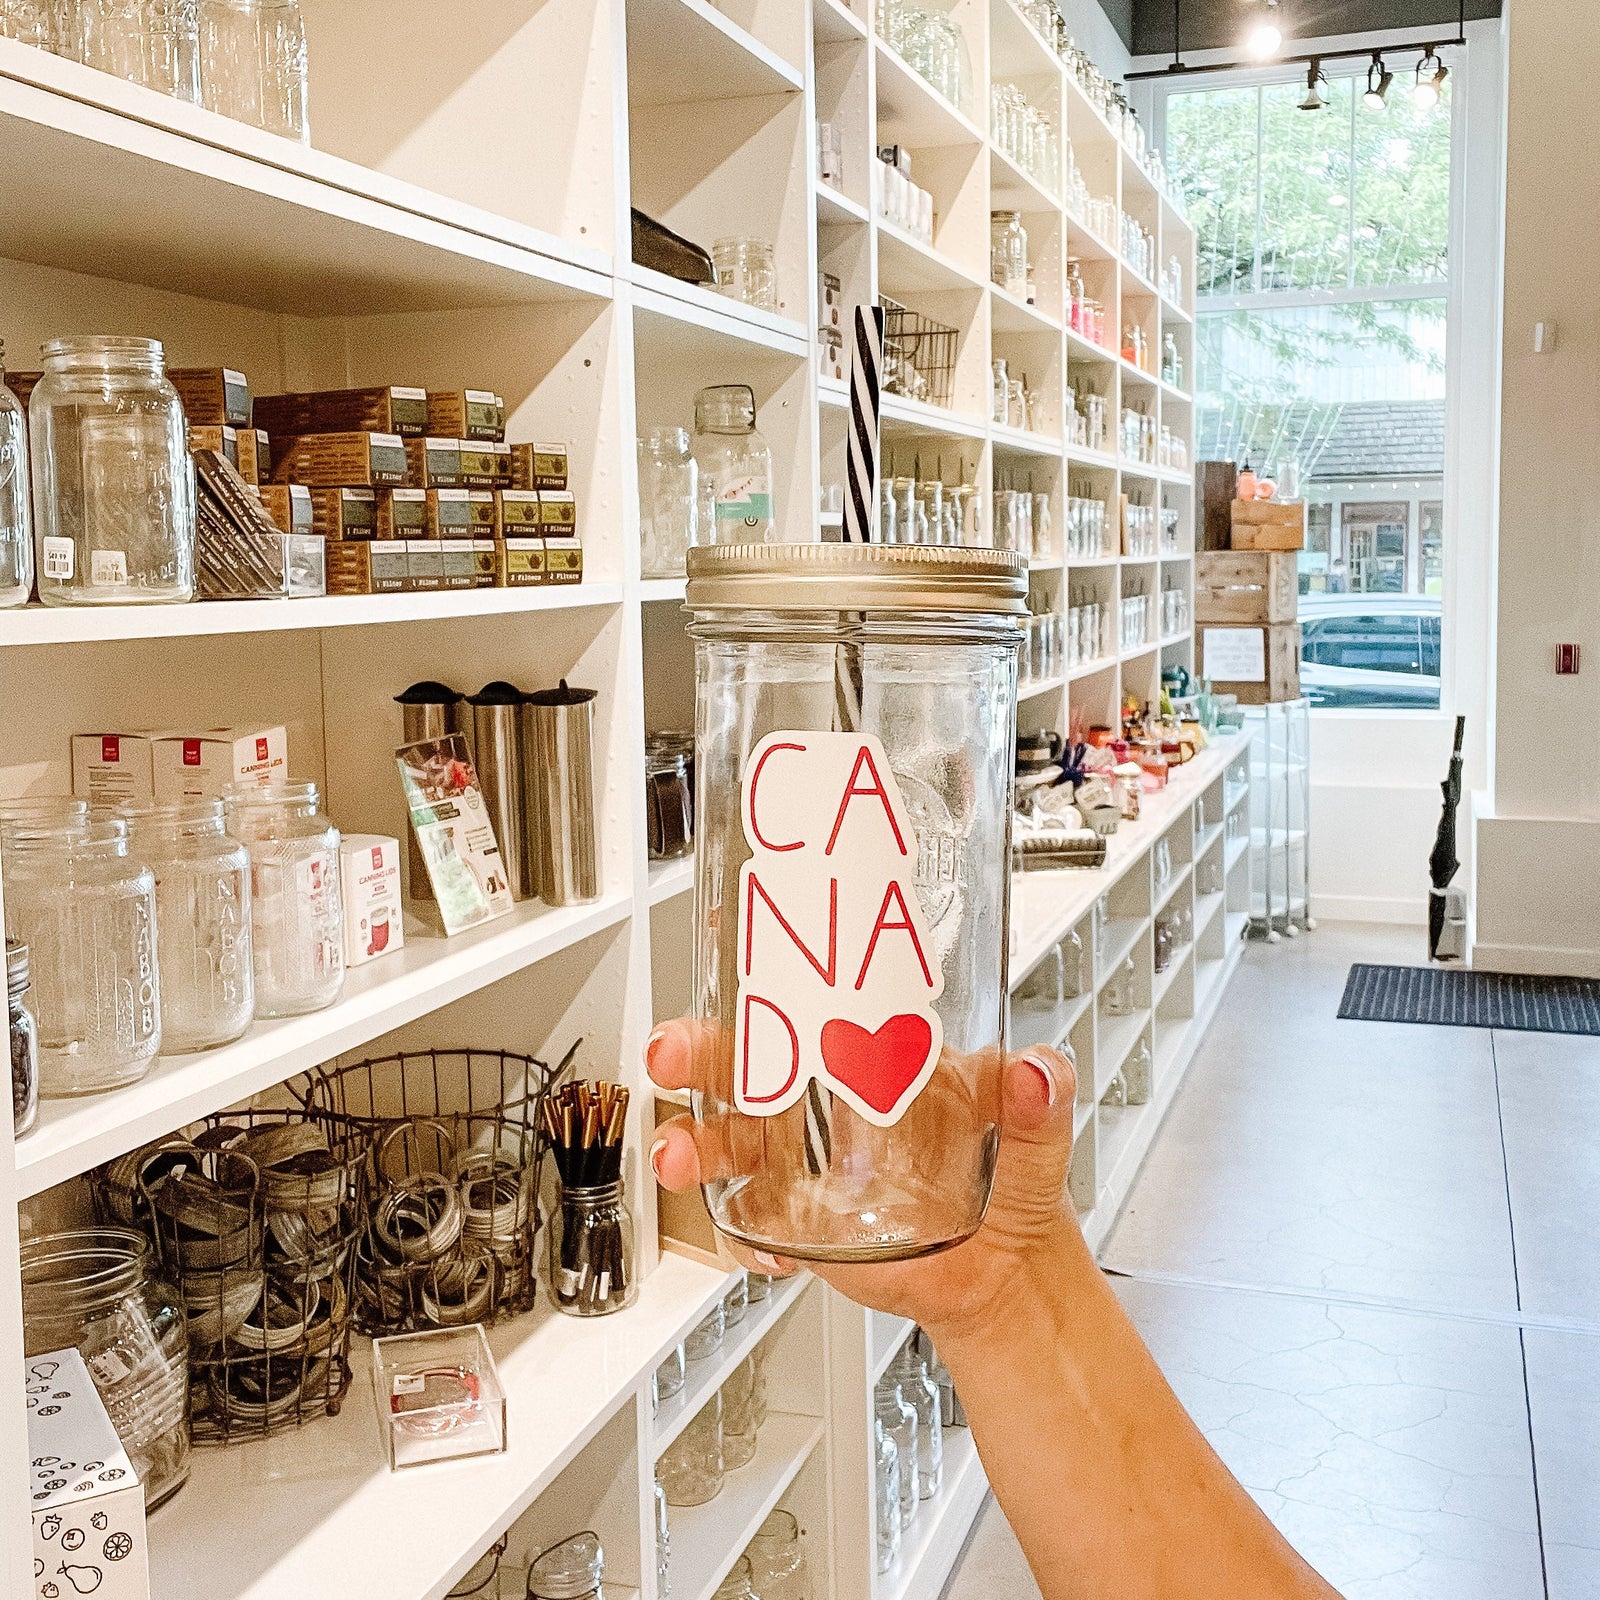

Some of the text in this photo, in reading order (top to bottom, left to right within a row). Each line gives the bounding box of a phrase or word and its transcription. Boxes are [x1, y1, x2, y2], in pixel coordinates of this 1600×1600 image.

[240, 757, 283, 775] CANNING LIDS
[359, 865, 397, 885] CANNING LIDS
